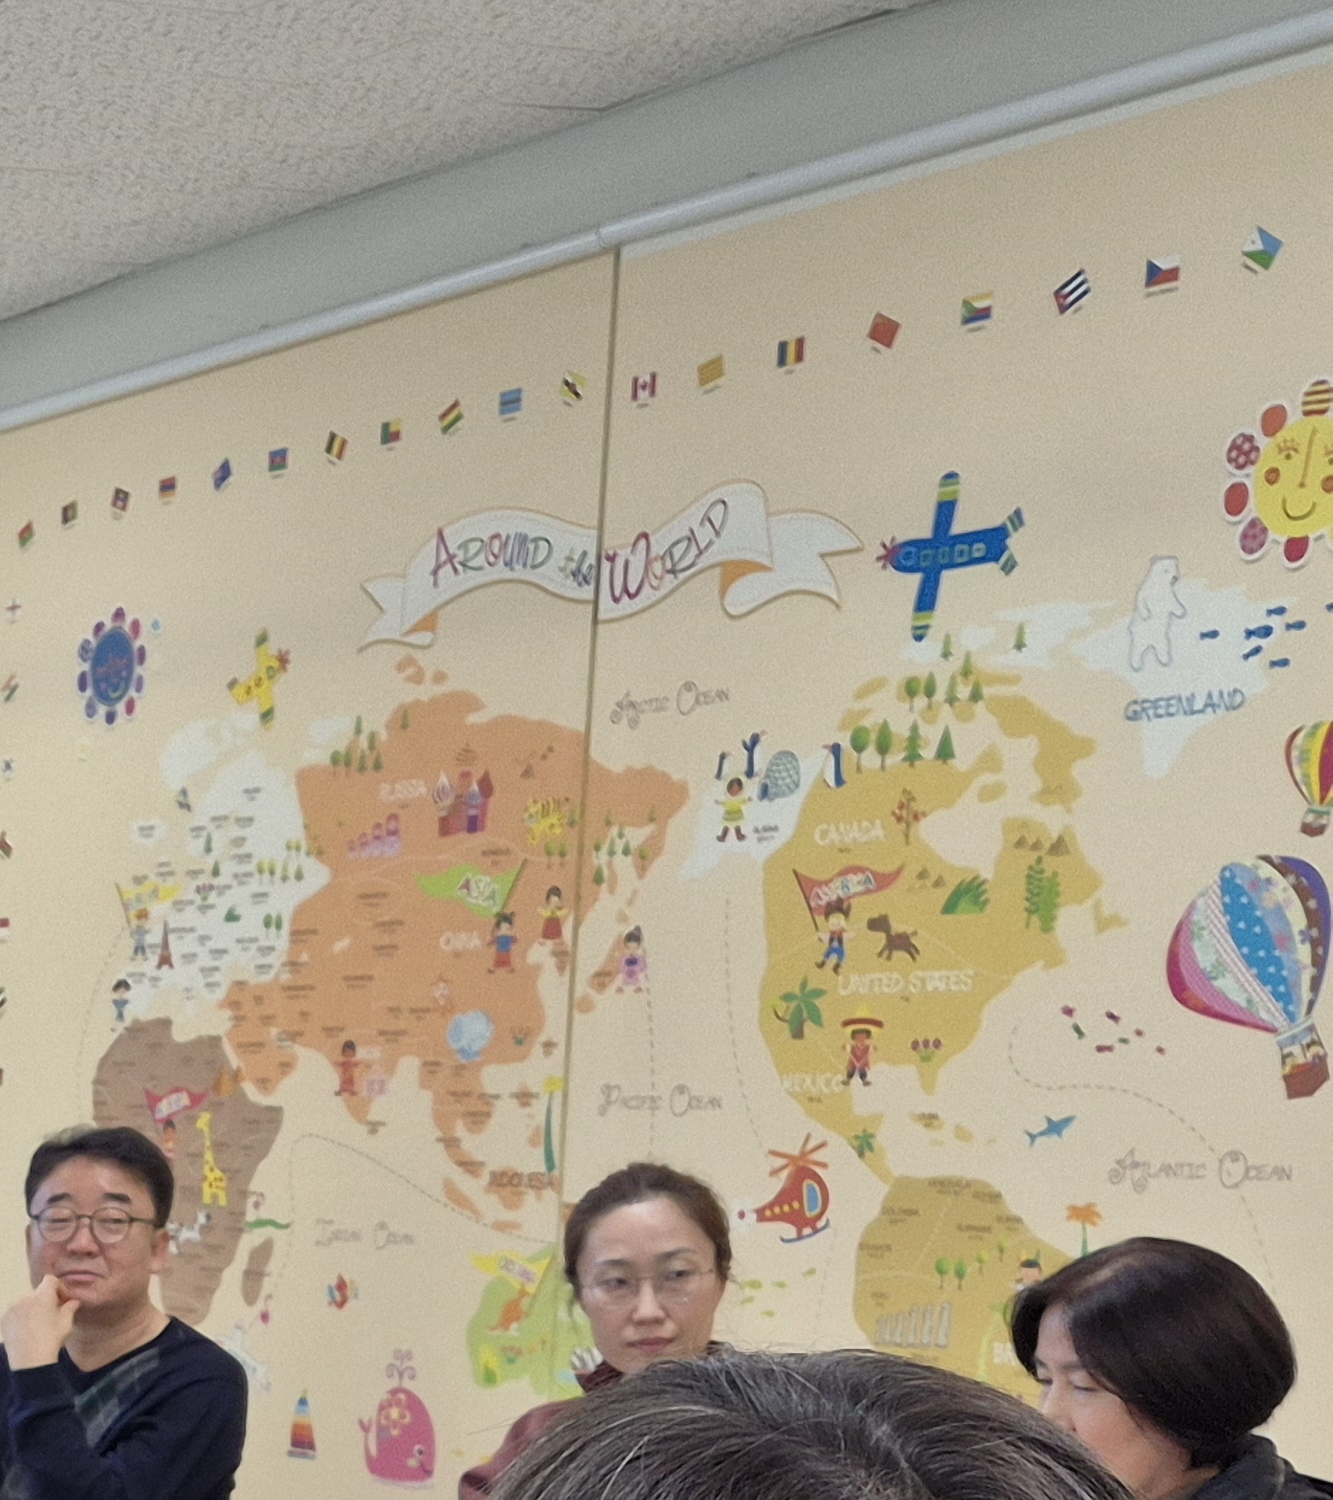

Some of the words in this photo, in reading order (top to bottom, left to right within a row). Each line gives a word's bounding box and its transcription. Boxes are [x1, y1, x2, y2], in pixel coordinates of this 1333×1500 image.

[605, 498, 729, 604] WORLD
[1123, 688, 1247, 723] GREENLAND
[837, 972, 904, 997] UNITED
[909, 969, 975, 995] STATES
[1108, 1146, 1207, 1195] ATLANTIC
[1219, 1149, 1293, 1190] OCEAN
